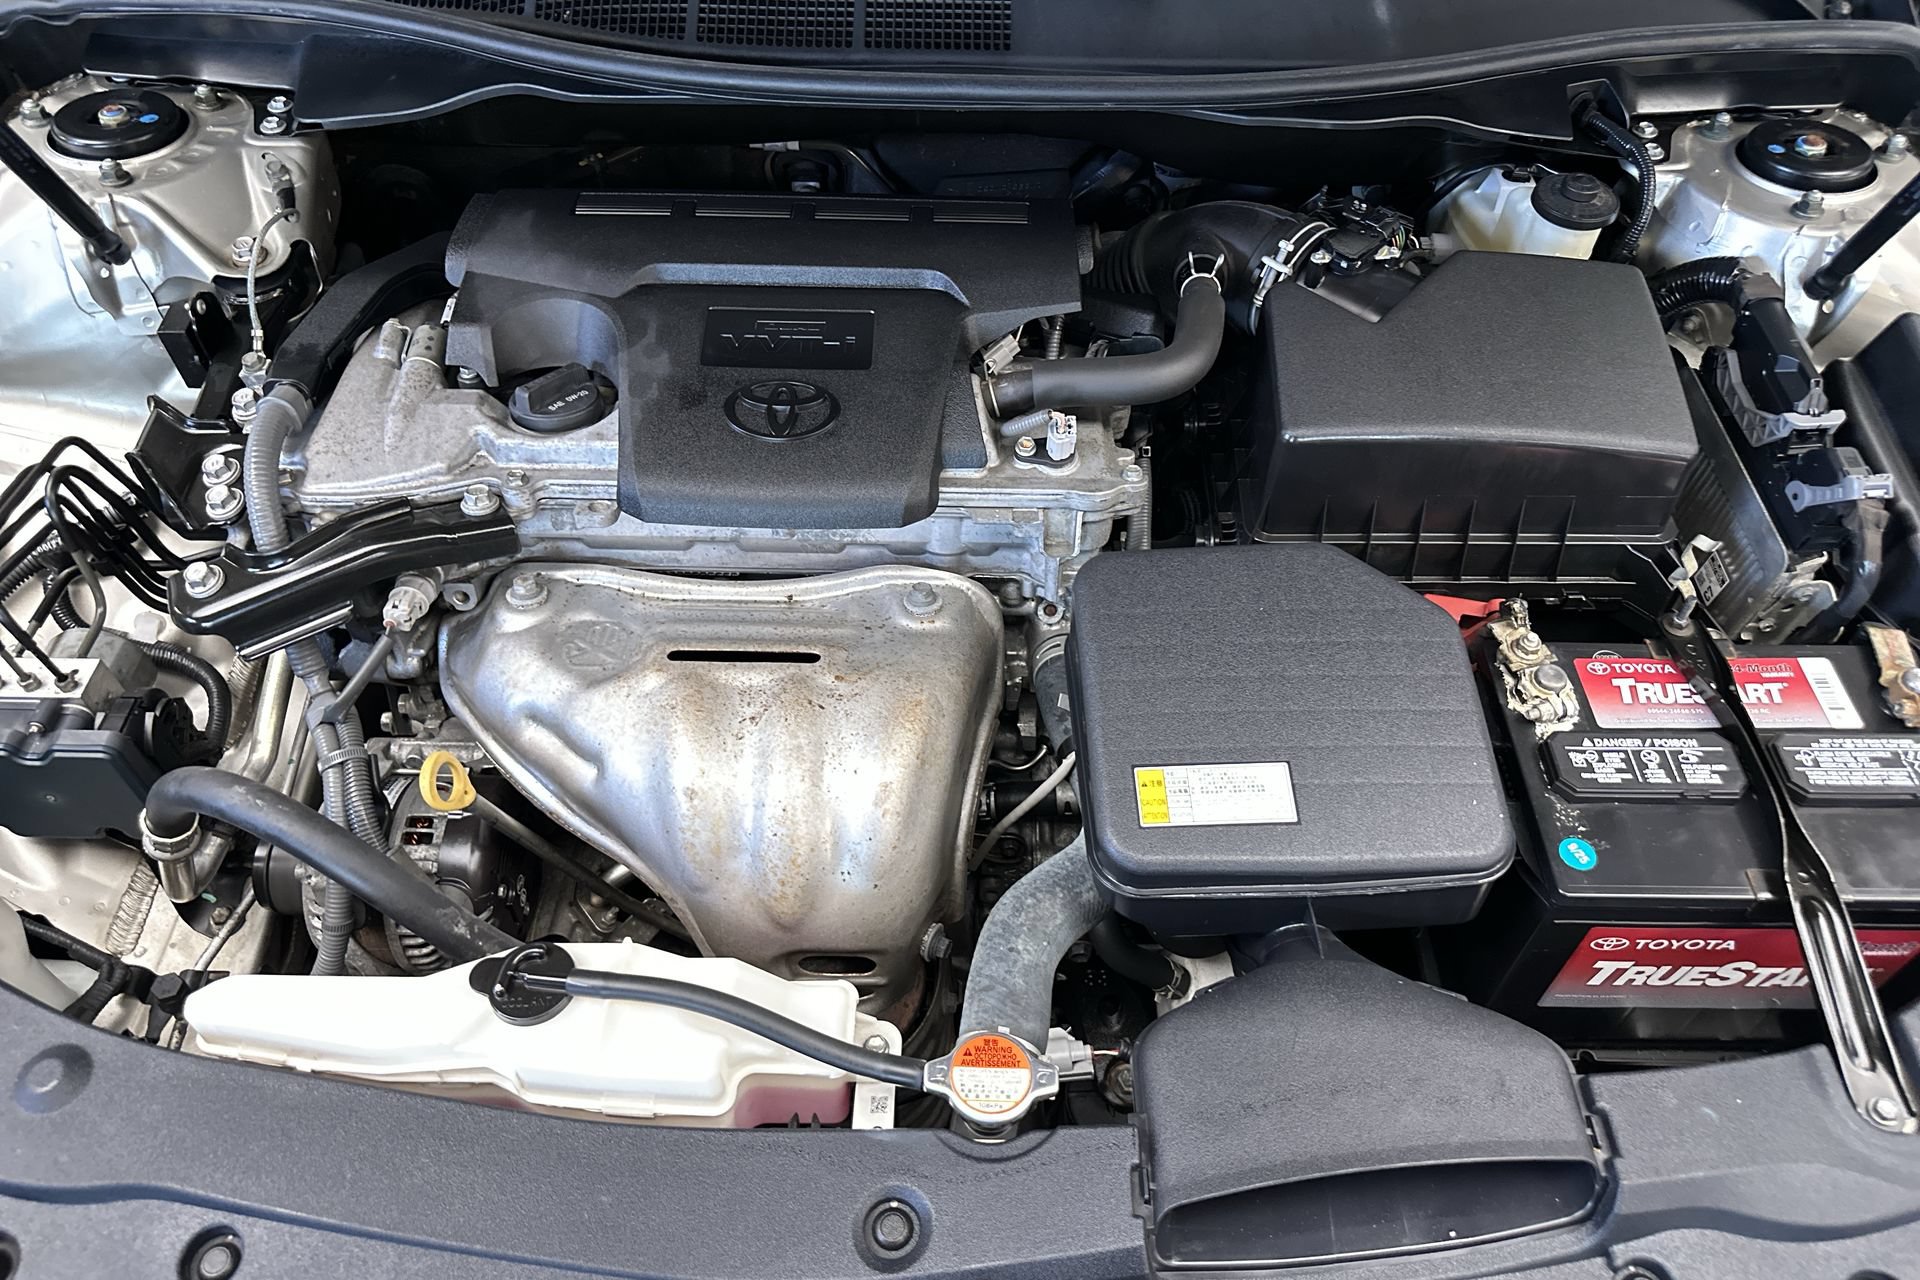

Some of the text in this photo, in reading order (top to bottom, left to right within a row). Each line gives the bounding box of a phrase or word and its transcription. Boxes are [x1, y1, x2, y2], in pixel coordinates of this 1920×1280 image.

[548, 390, 589, 411] SAE 0W-20
[1611, 663, 1677, 674] TOYOTA
[1594, 738, 1642, 747] DANGER
[1654, 739, 1698, 748] POISON
[1567, 843, 1590, 865] 9/25
[1635, 939, 1736, 950] TOYOTA
[974, 1046, 1013, 1054] WARNING
[961, 1059, 1021, 1068] AVERTISSEMENT
